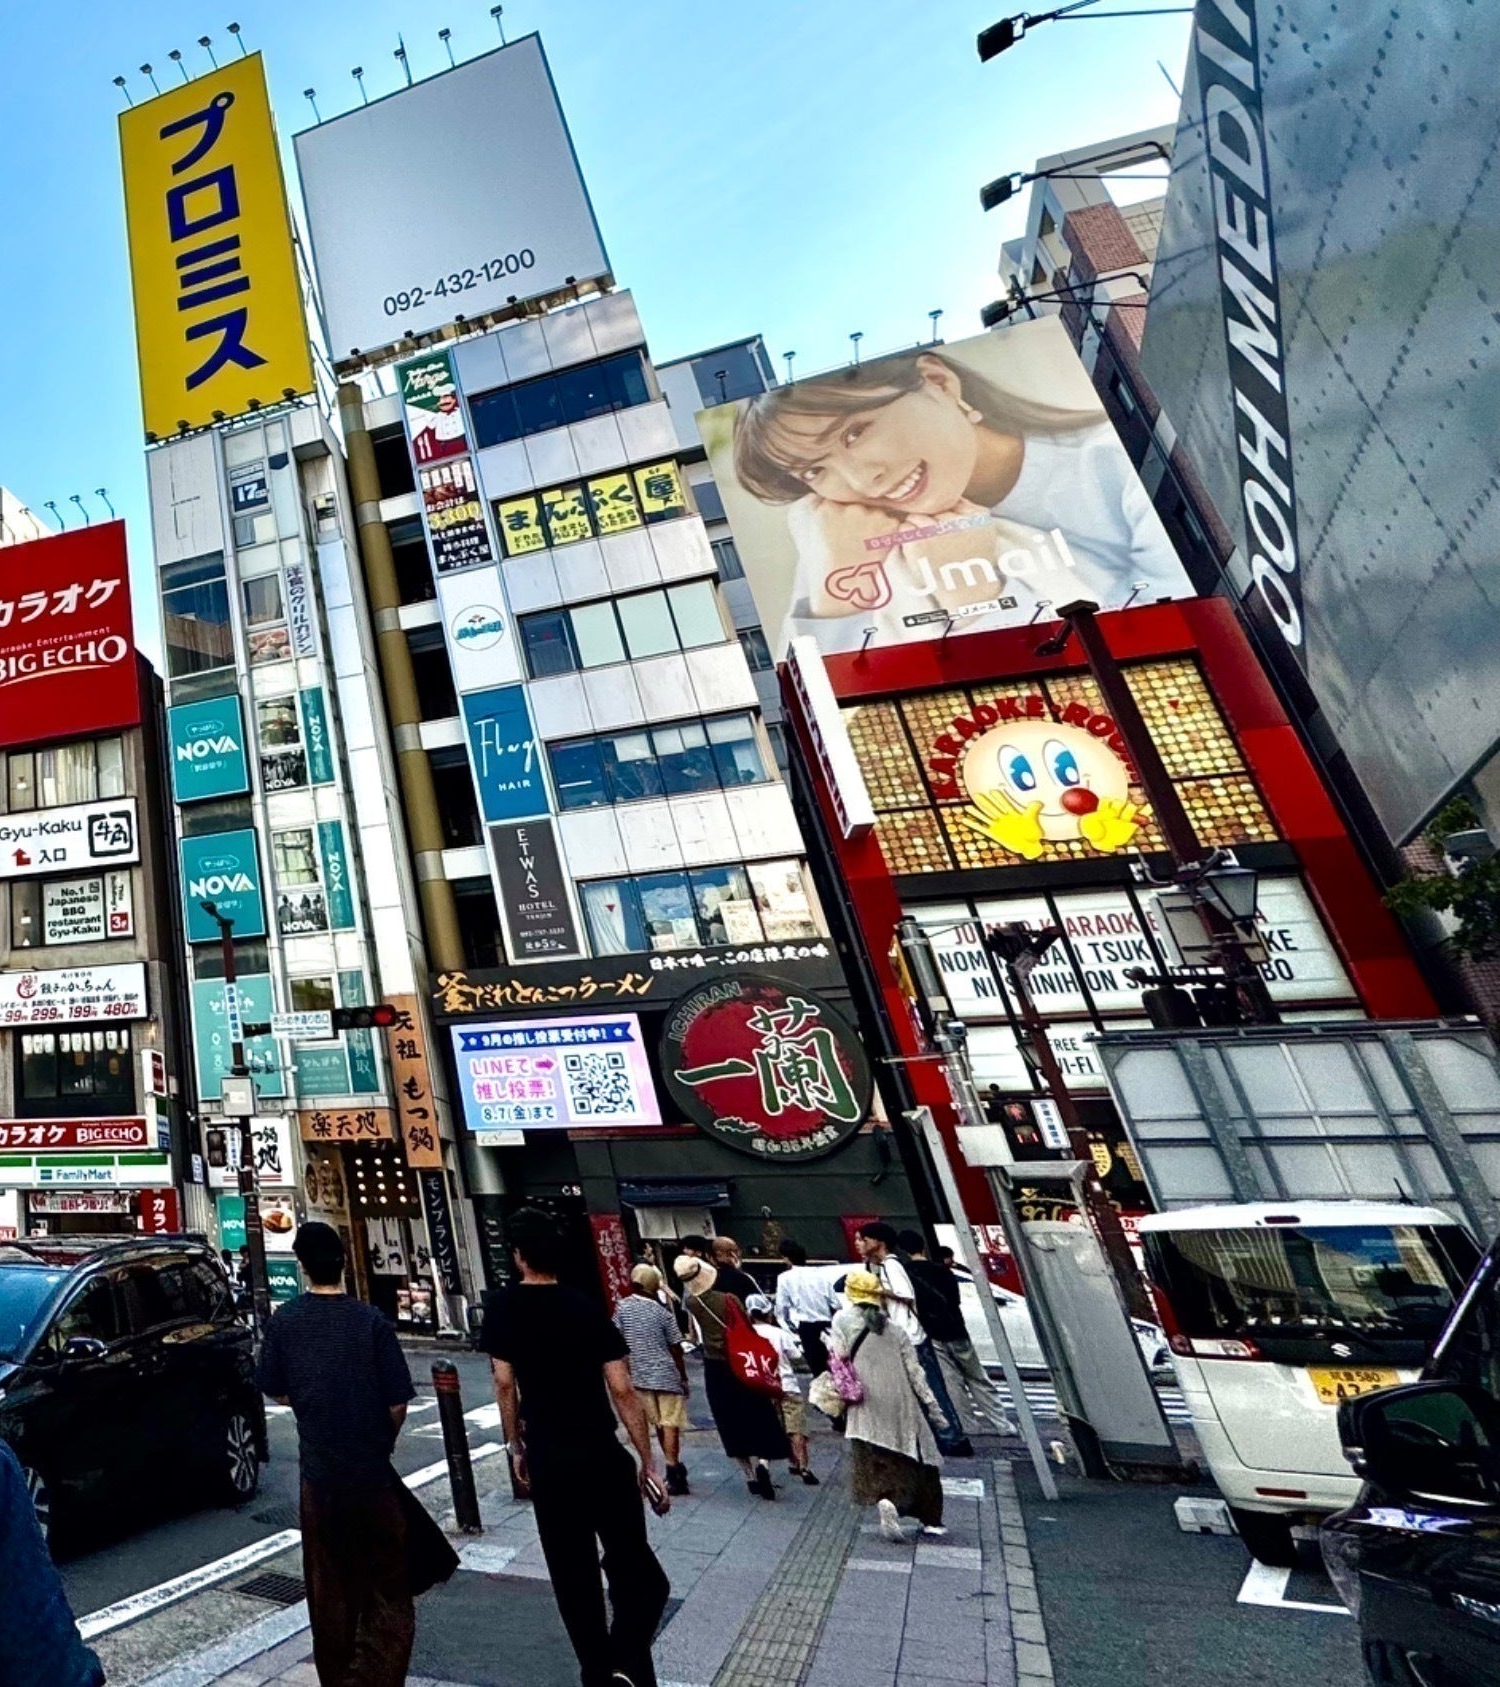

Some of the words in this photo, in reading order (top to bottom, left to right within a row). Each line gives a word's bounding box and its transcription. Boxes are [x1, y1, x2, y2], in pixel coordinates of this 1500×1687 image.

[159, 90, 269, 392] プロミス
[382, 247, 536, 316] 092-432-1200
[1233, 386, 1303, 648] OOH
[908, 528, 1076, 597] Jmail
[36, 625, 112, 648] Entertainment
[42, 634, 129, 669] ECHO
[309, 715, 325, 752] NOVA
[929, 694, 1046, 800] KARAOKE
[176, 735, 241, 762] NOVA
[265, 778, 297, 791] NOVA
[498, 779, 532, 792] HAIR
[37, 846, 68, 865] 入口
[515, 828, 541, 899] ETWAS
[188, 872, 257, 900] NOVA
[328, 852, 346, 893] NOVA
[47, 894, 100, 907] Japanese
[60, 886, 85, 897] No.1
[62, 906, 86, 917] BBQ
[518, 900, 557, 913] HOTEL
[47, 914, 102, 928] restaurant
[49, 924, 102, 939] Gyu-Kaku
[282, 920, 320, 933] NOVA
[432, 971, 655, 1013] 釜だれとんこつラーメン
[667, 980, 744, 1043] ICHIRAN
[674, 996, 861, 1123] 一蘭
[393, 1009, 435, 1153] 元祖もつ鍋
[475, 1079, 554, 1100] 推し投票!
[76, 1127, 103, 1144] BIG
[105, 1125, 144, 1142] ECHO
[310, 1110, 382, 1138] 楽天地
[55, 1168, 113, 1182] FamilyMart
[426, 1176, 456, 1290] モンブランビル
[268, 1274, 299, 1288] NOVA
